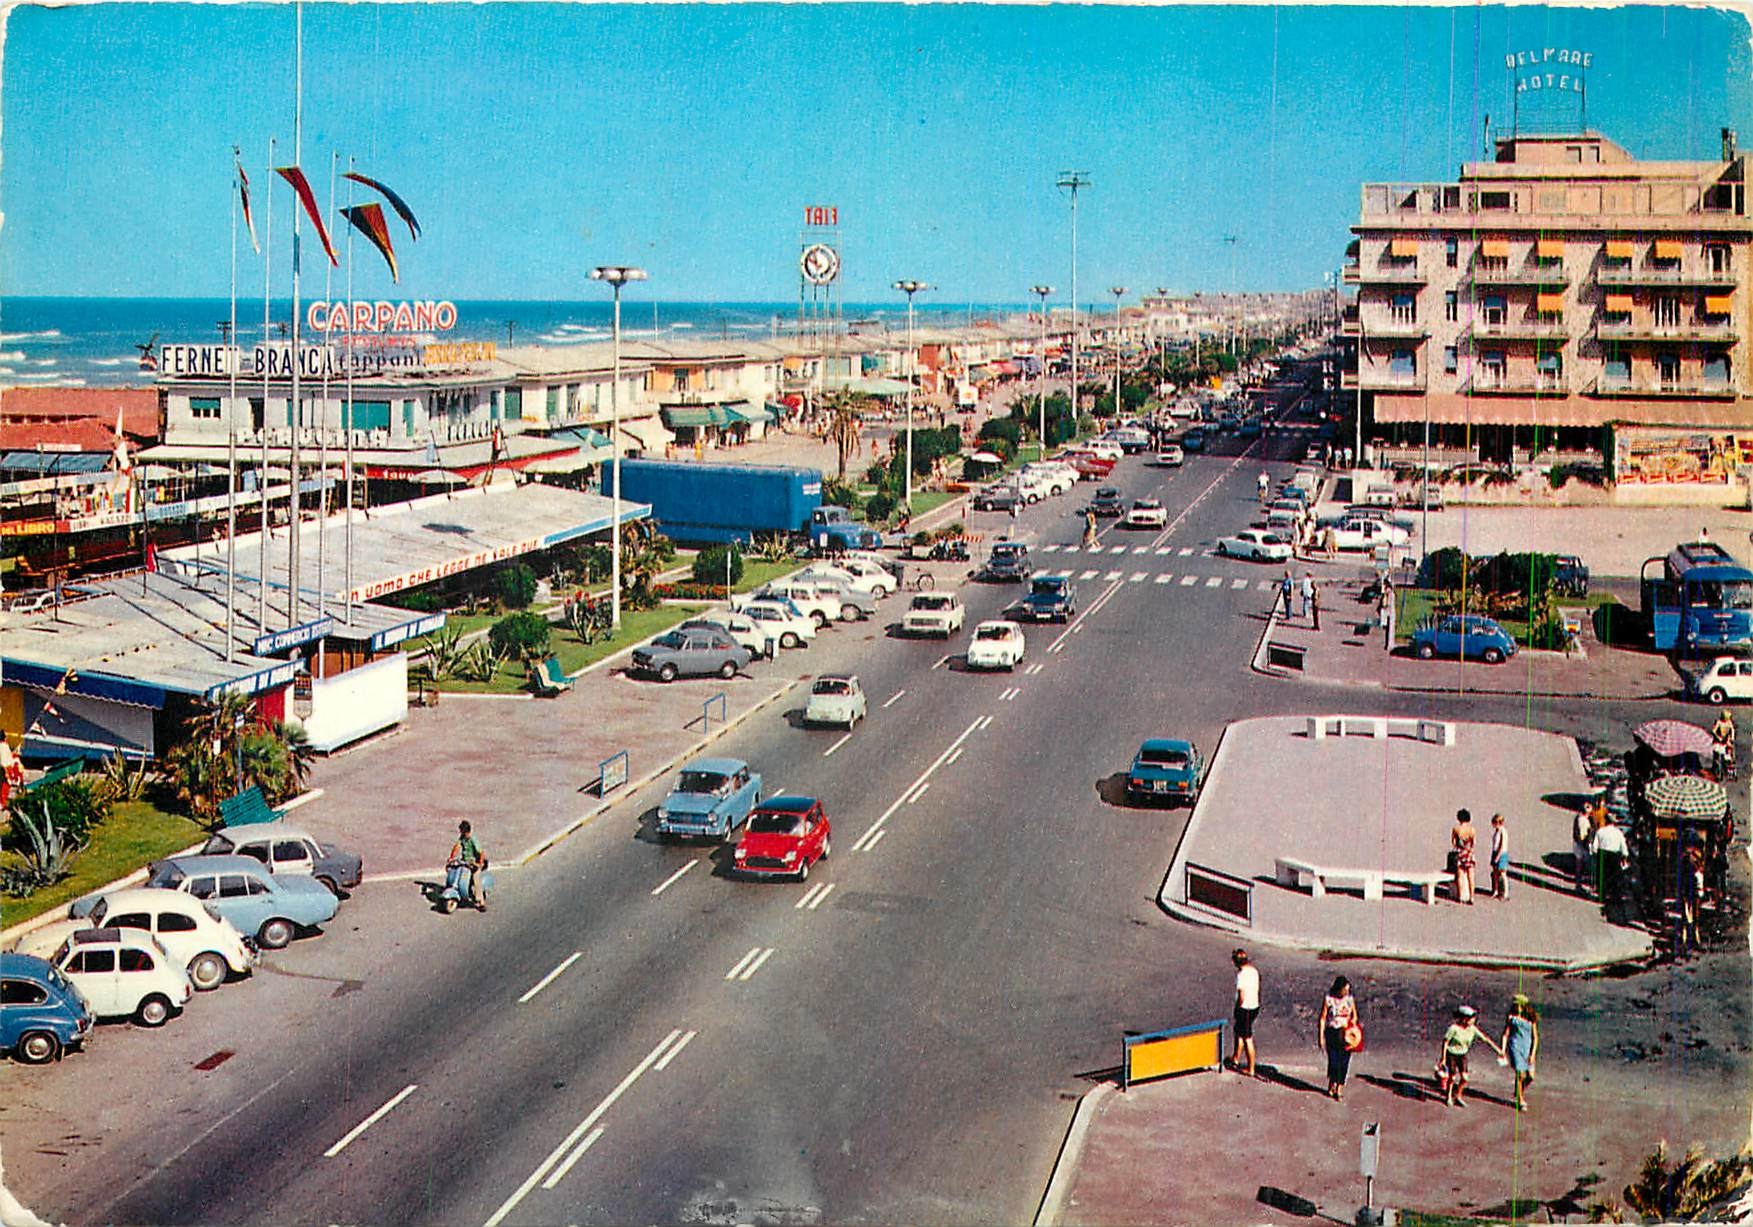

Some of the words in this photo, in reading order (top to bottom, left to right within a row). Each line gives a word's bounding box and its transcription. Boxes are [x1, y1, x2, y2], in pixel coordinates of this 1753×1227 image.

[1517, 74, 1583, 92] HOTEL
[308, 301, 457, 332] CARPANO
[16, 522, 55, 535] LIBRO
[409, 569, 432, 586] CHE
[436, 558, 470, 577] LEGGE
